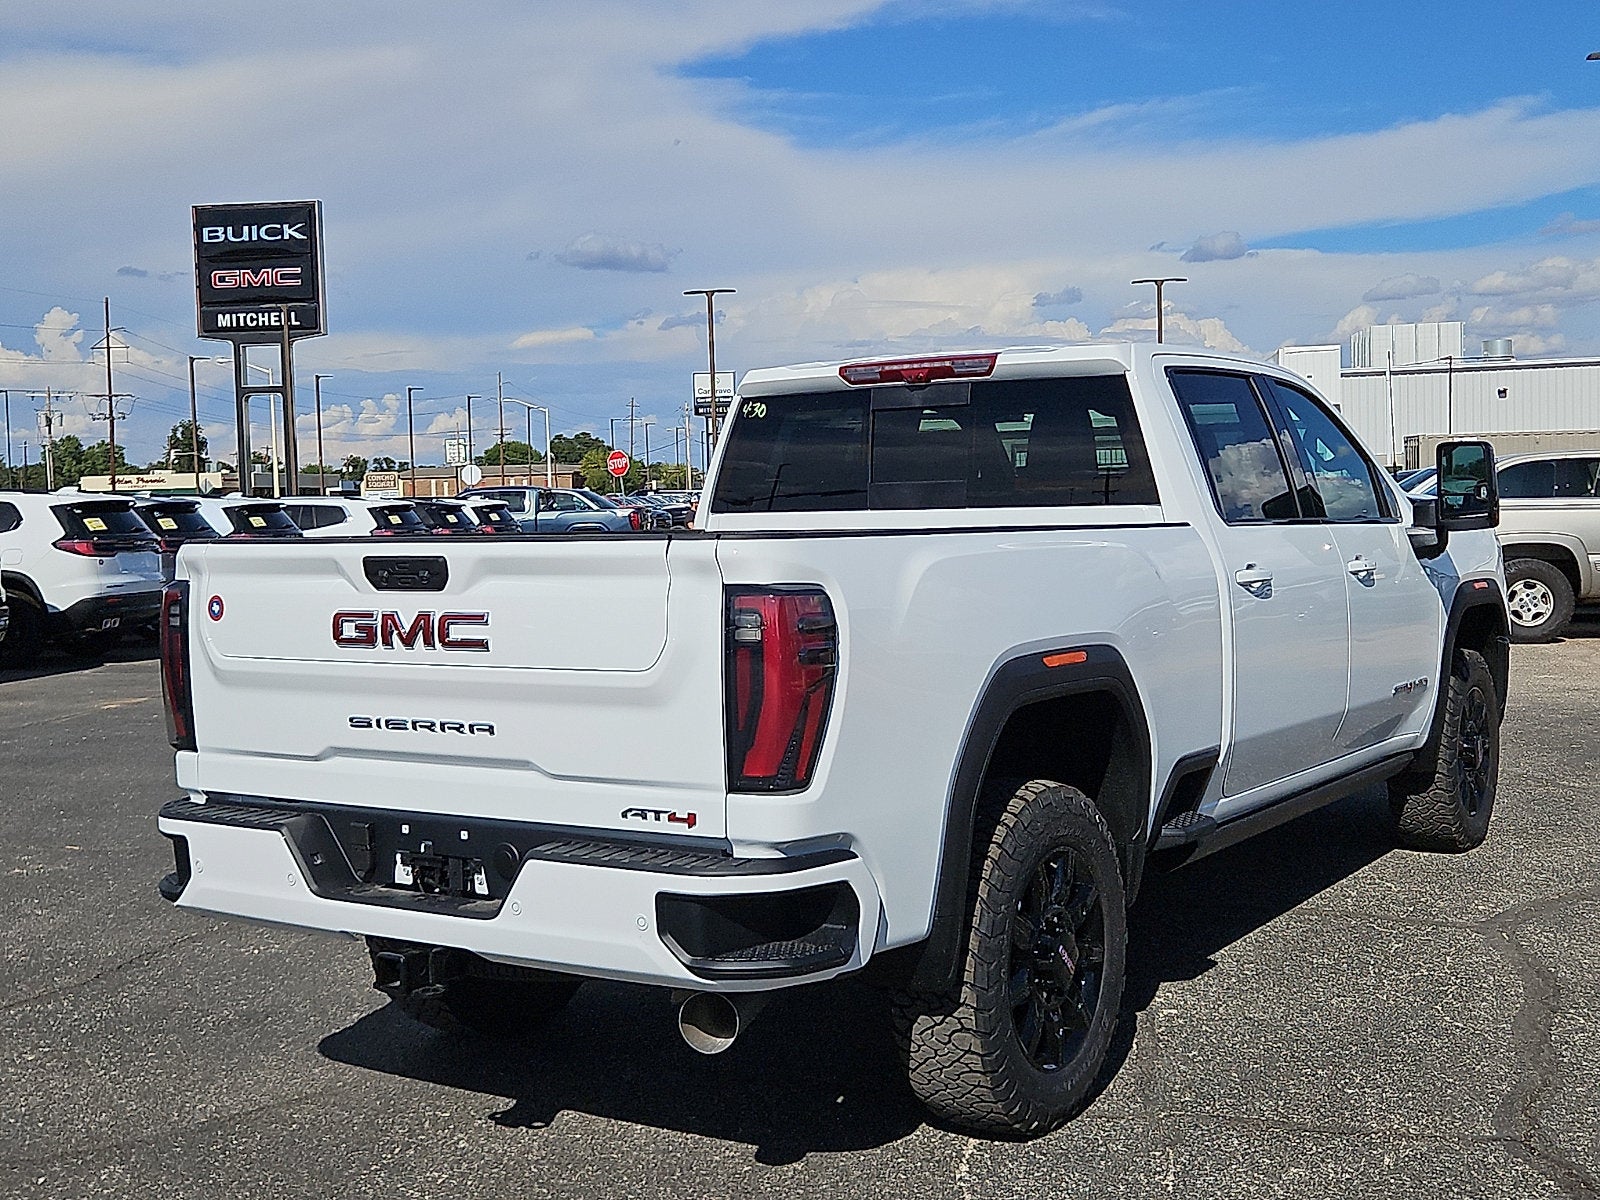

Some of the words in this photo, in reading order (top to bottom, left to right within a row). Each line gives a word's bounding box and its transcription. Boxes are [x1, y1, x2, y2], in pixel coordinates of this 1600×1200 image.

[202, 222, 308, 243] BUICK
[211, 267, 302, 289] GMC
[217, 311, 301, 328] MITCHELL
[697, 387, 732, 395] Carravo
[609, 457, 627, 470] STOP
[332, 609, 491, 652] GMC
[348, 716, 496, 737] SIERRA
[621, 807, 697, 829] AT4
